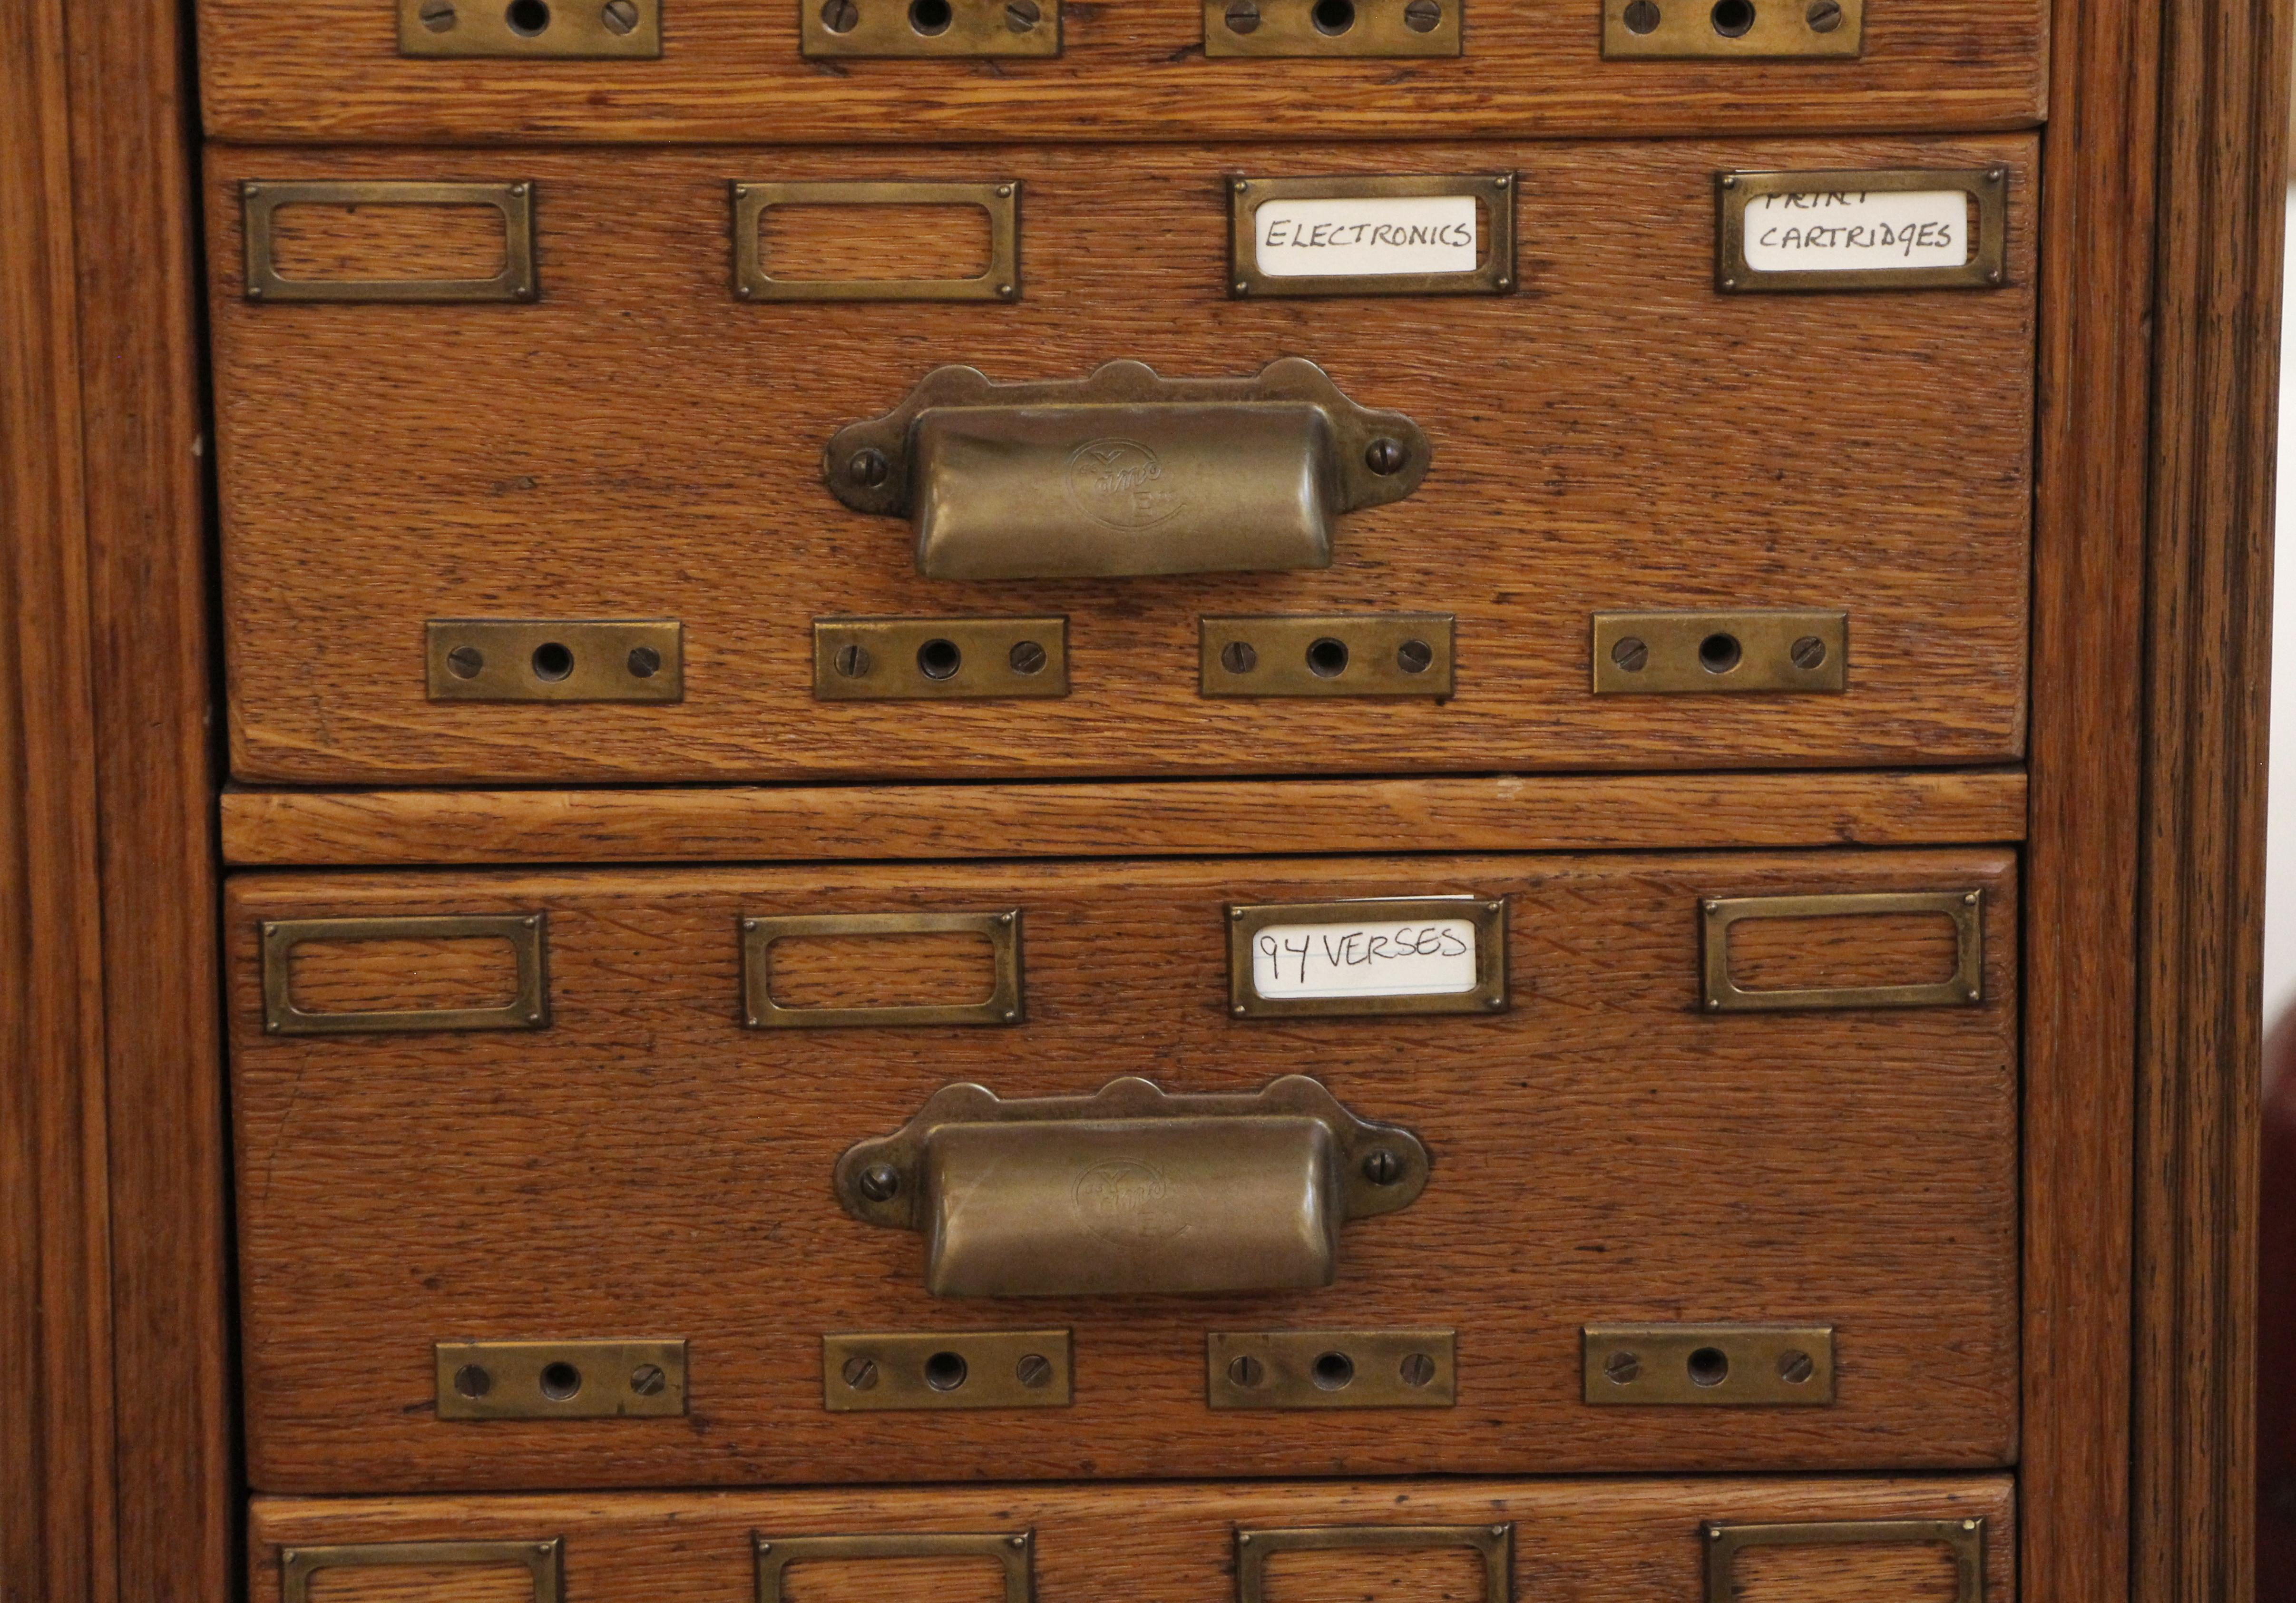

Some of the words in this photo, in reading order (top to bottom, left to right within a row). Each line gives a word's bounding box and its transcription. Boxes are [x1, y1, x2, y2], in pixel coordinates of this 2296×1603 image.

[1265, 219, 1472, 247] ELECTRONICS
[1759, 222, 1952, 257] CARTRIDGES
[1260, 935, 1310, 983] 94
[1323, 927, 1467, 967] VERSES
